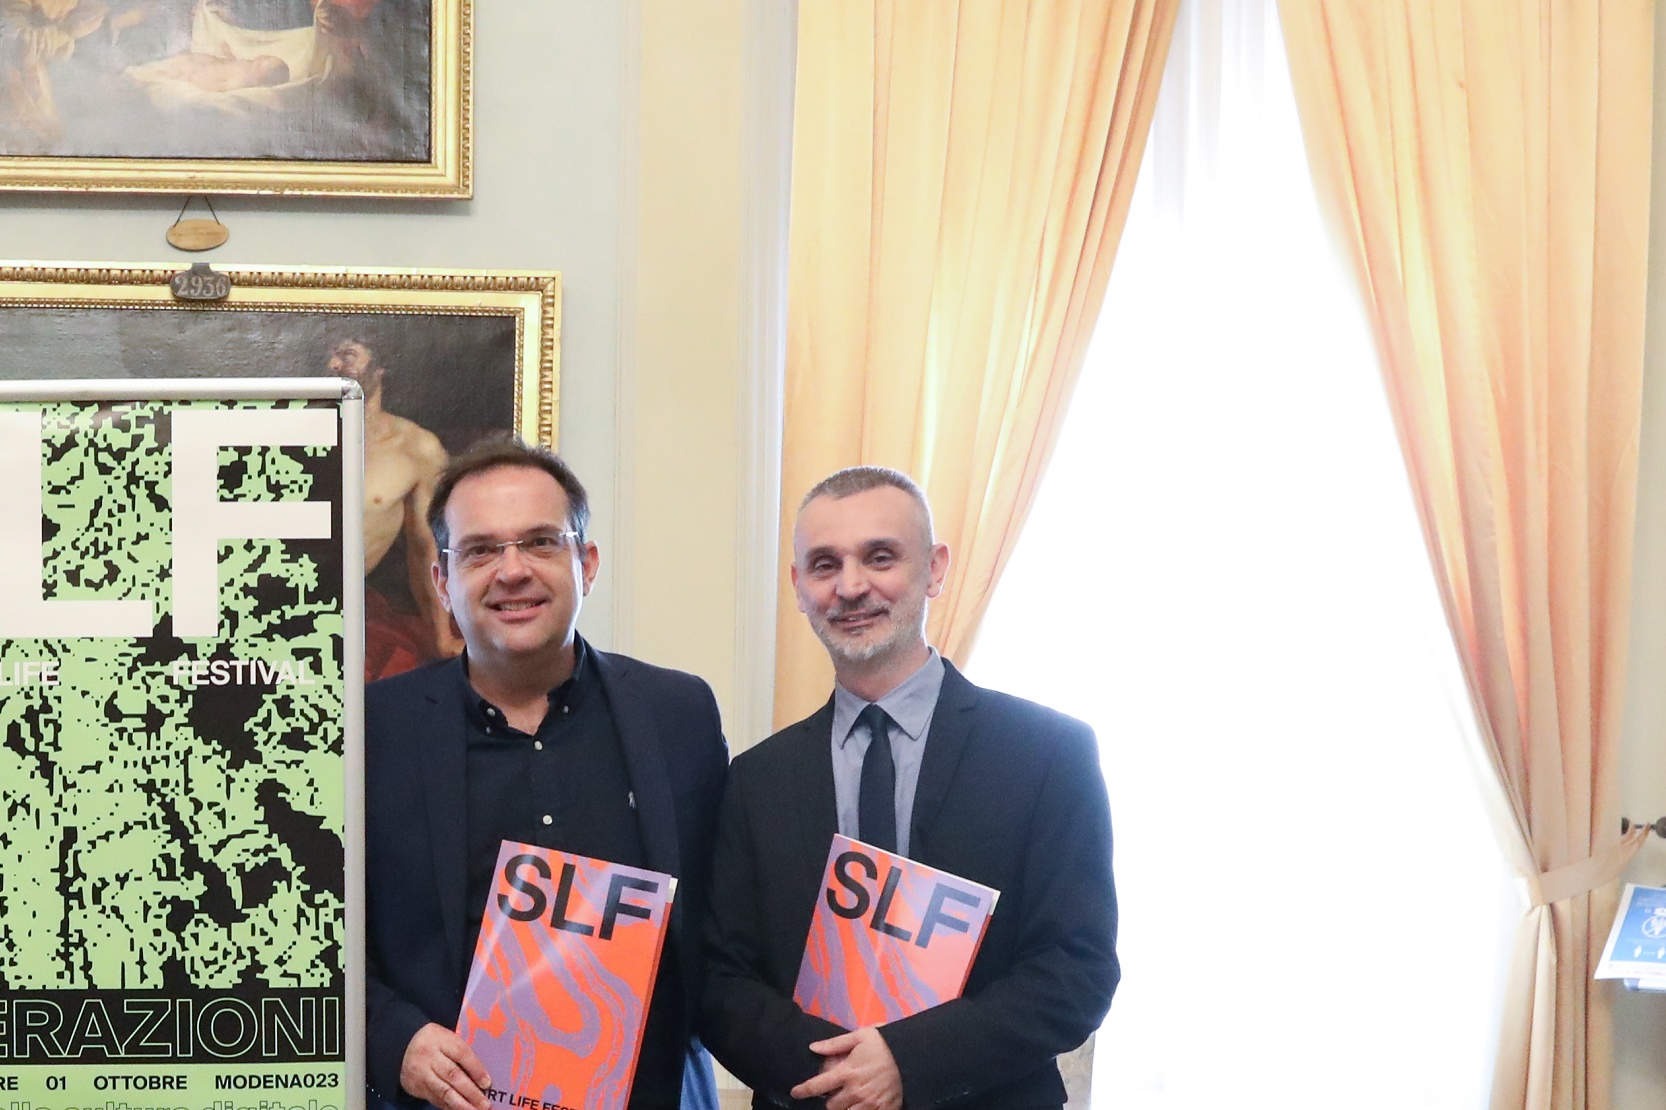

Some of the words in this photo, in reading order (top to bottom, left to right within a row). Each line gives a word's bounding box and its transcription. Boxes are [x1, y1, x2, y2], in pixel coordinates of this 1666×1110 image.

[174, 276, 227, 297] 2936
[172, 660, 316, 686] FESTIVAL
[497, 854, 659, 941] SLF
[826, 851, 981, 949] SLF
[45, 1075, 67, 1091] 01
[93, 1075, 188, 1091] OTTOBRE
[215, 1073, 339, 1090] MODENA023
